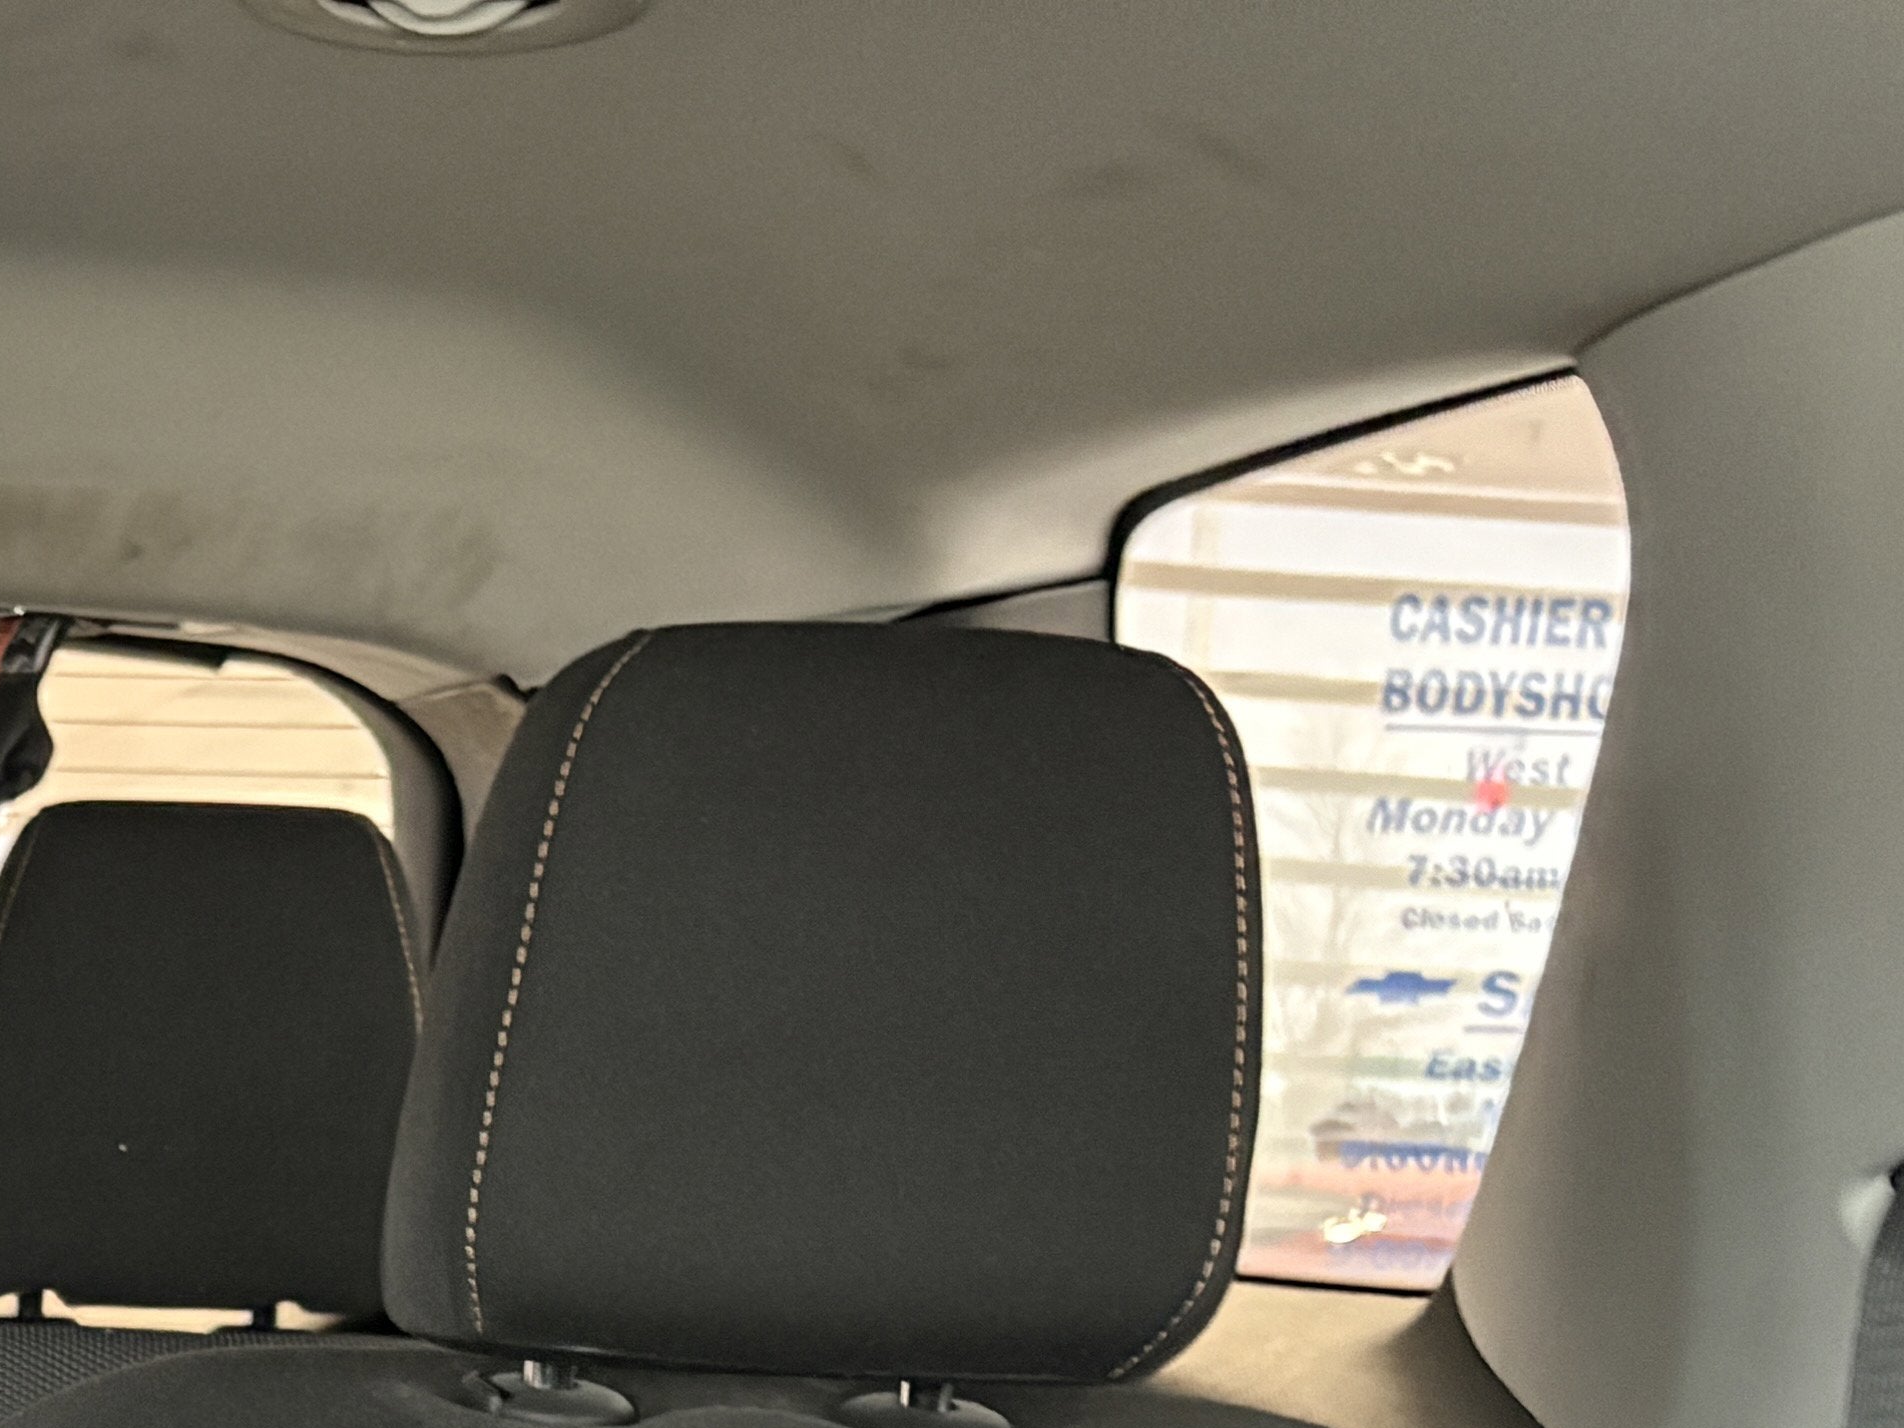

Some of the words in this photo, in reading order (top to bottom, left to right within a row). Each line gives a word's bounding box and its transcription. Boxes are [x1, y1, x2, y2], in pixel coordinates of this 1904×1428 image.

[1391, 593, 1613, 648] CASHIER
[1466, 748, 1570, 786] West
[1366, 796, 1550, 846] Monday
[1424, 1047, 1515, 1082] Eas
